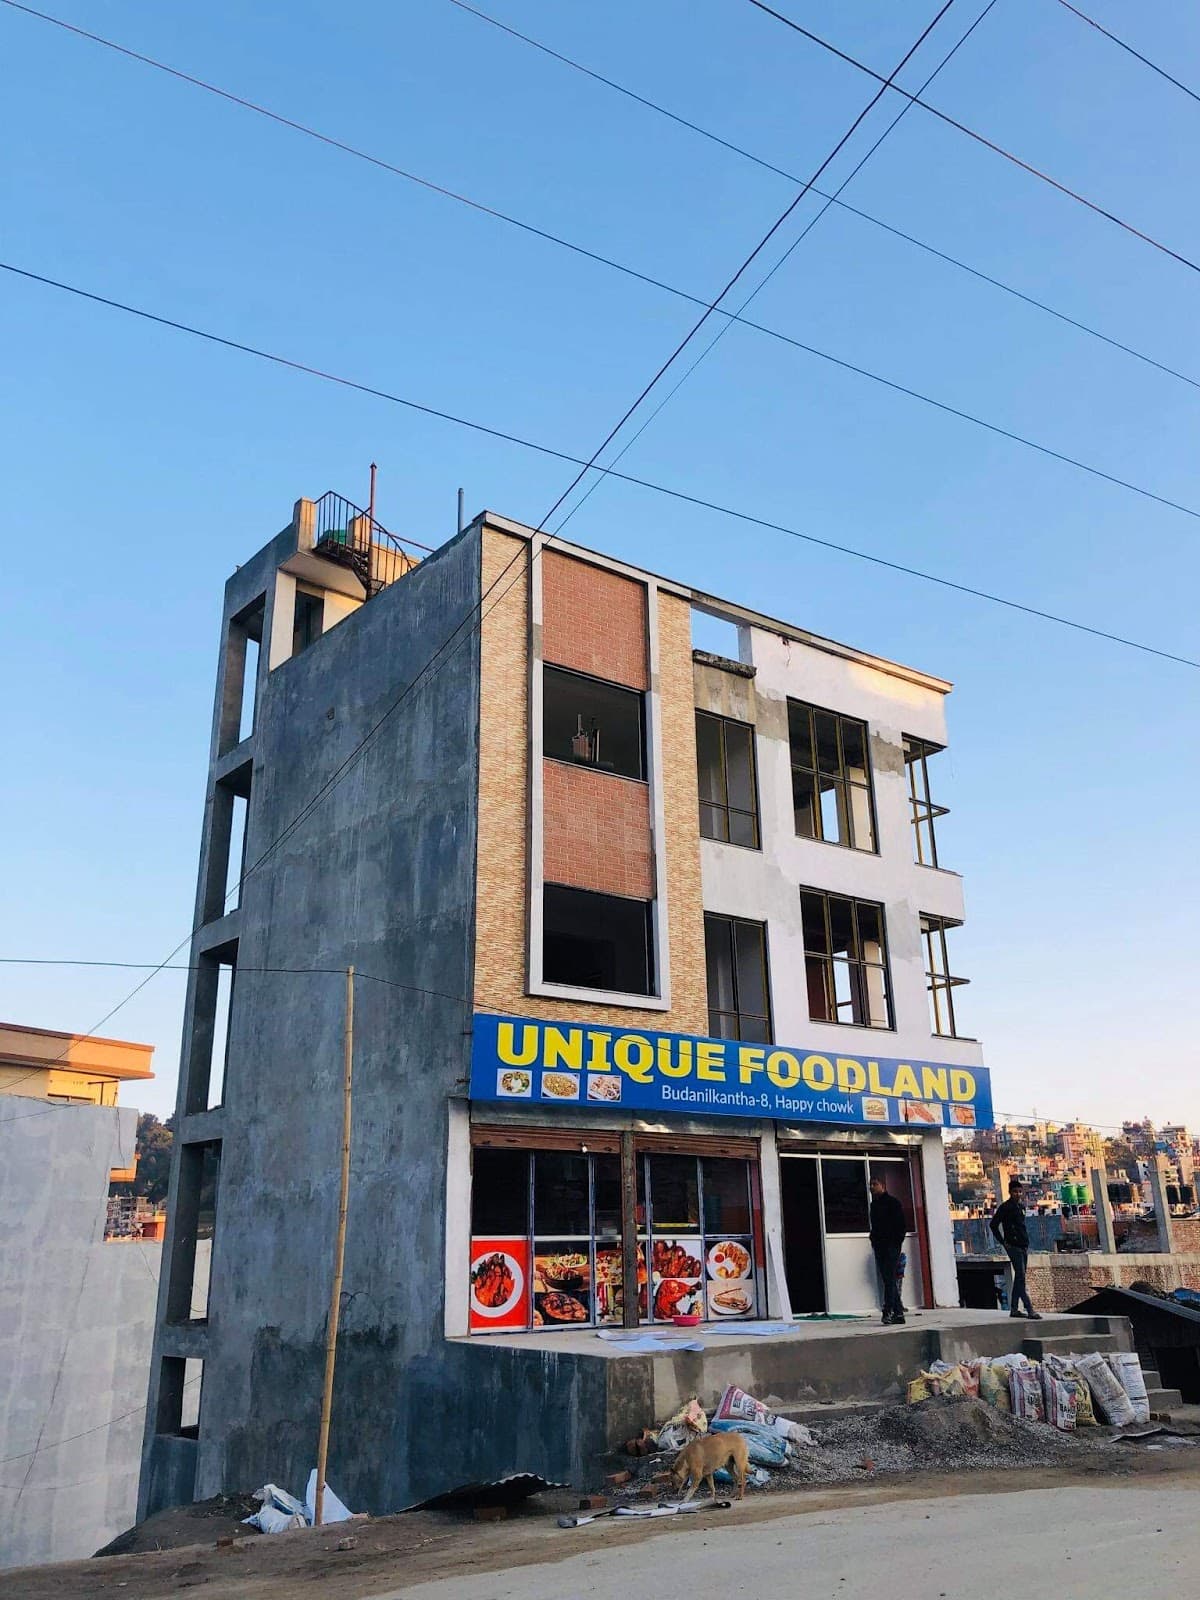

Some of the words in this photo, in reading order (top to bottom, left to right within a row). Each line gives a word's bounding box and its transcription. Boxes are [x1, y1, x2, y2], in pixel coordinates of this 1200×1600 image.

[498, 1022, 726, 1083] UNIQUE
[739, 1047, 976, 1102] FOODLAND
[661, 1085, 772, 1110] Budanilkantha-8,
[775, 1095, 814, 1114] Happy
[816, 1097, 855, 1115] chowk
